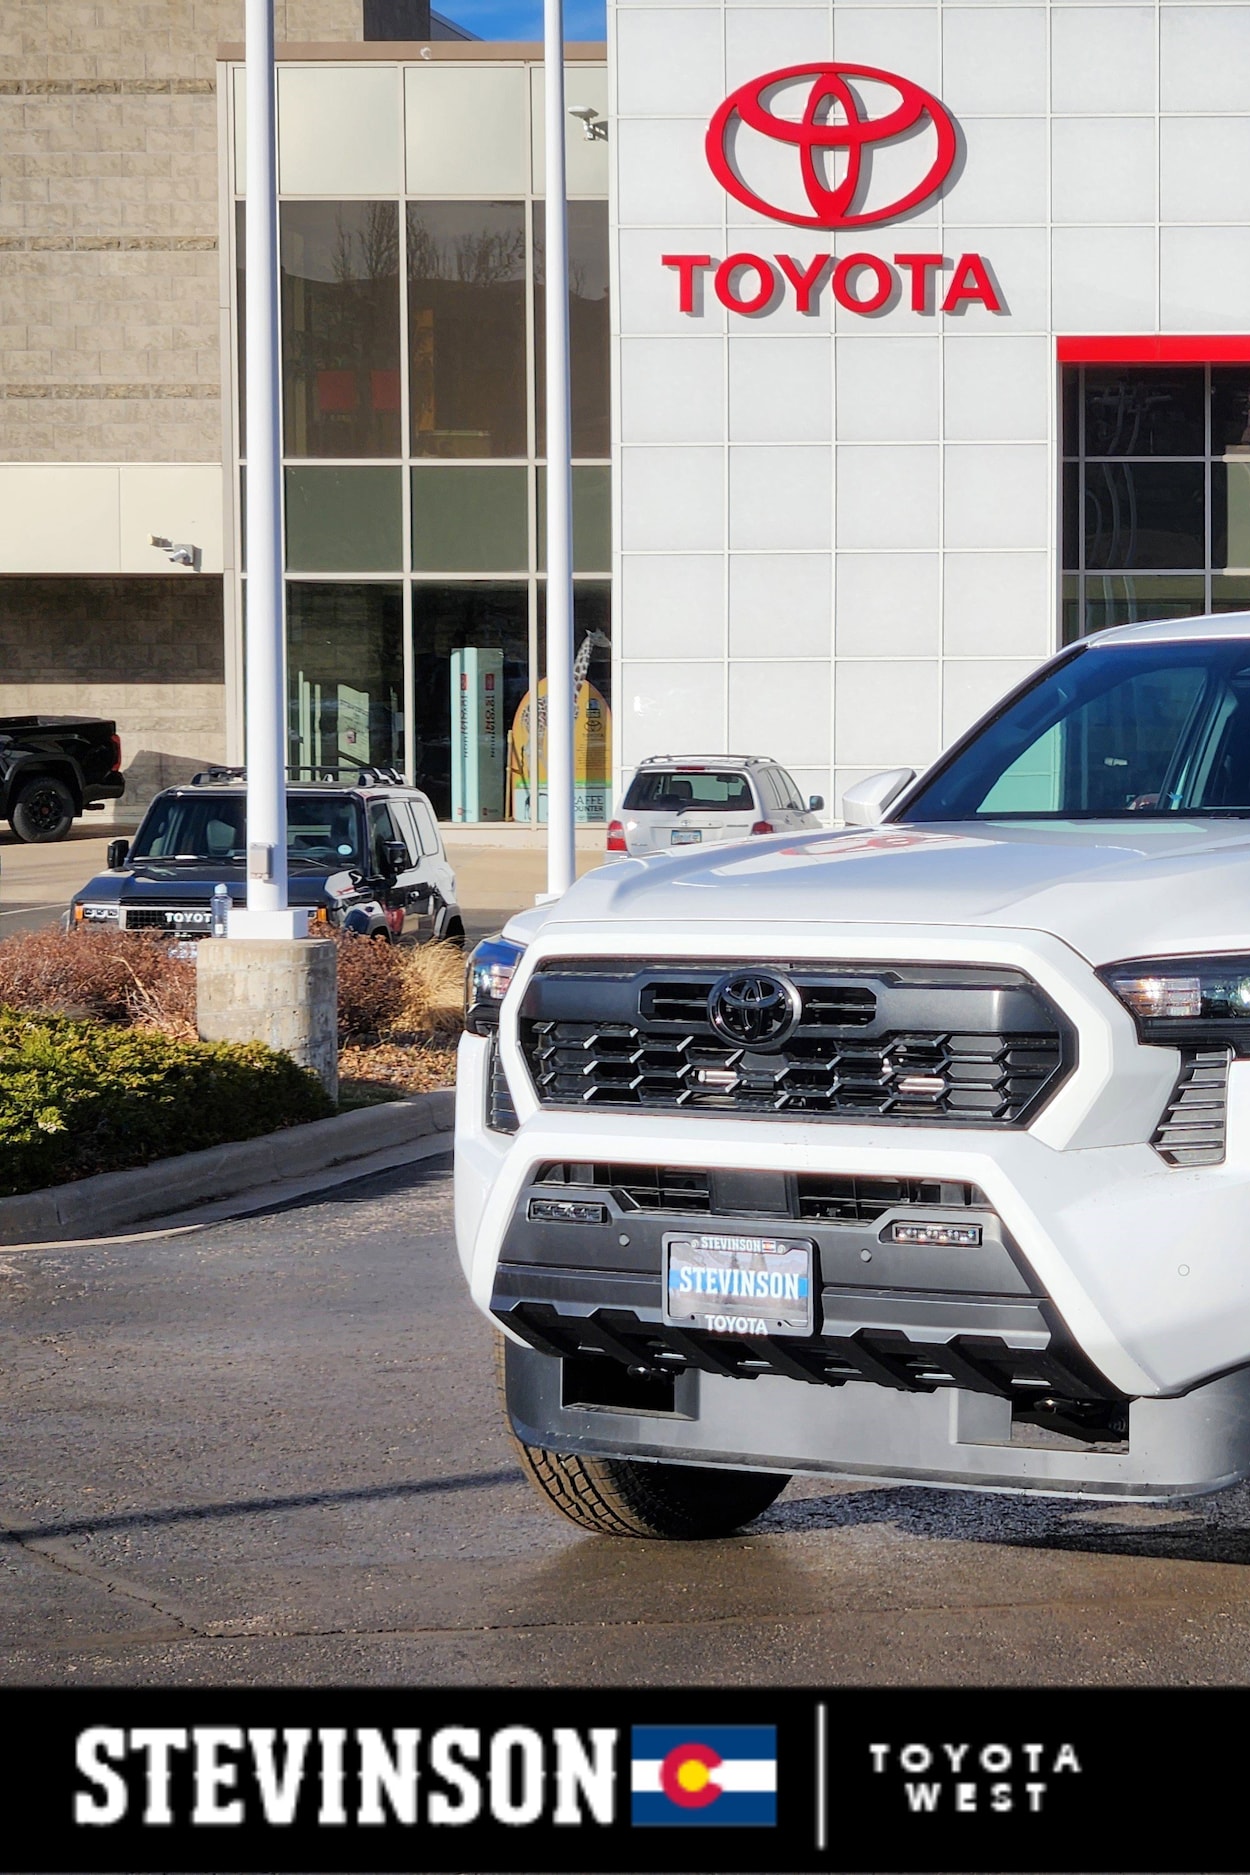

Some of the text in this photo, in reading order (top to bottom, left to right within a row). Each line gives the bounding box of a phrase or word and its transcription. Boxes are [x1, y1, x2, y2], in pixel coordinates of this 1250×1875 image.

[662, 252, 1001, 315] TOYOTA
[574, 795, 604, 805] AFFE
[165, 912, 213, 923] TOYOT
[701, 1237, 761, 1252] STEVINSON
[679, 1266, 800, 1300] STEVINSON
[704, 1315, 768, 1335] TOYOTA
